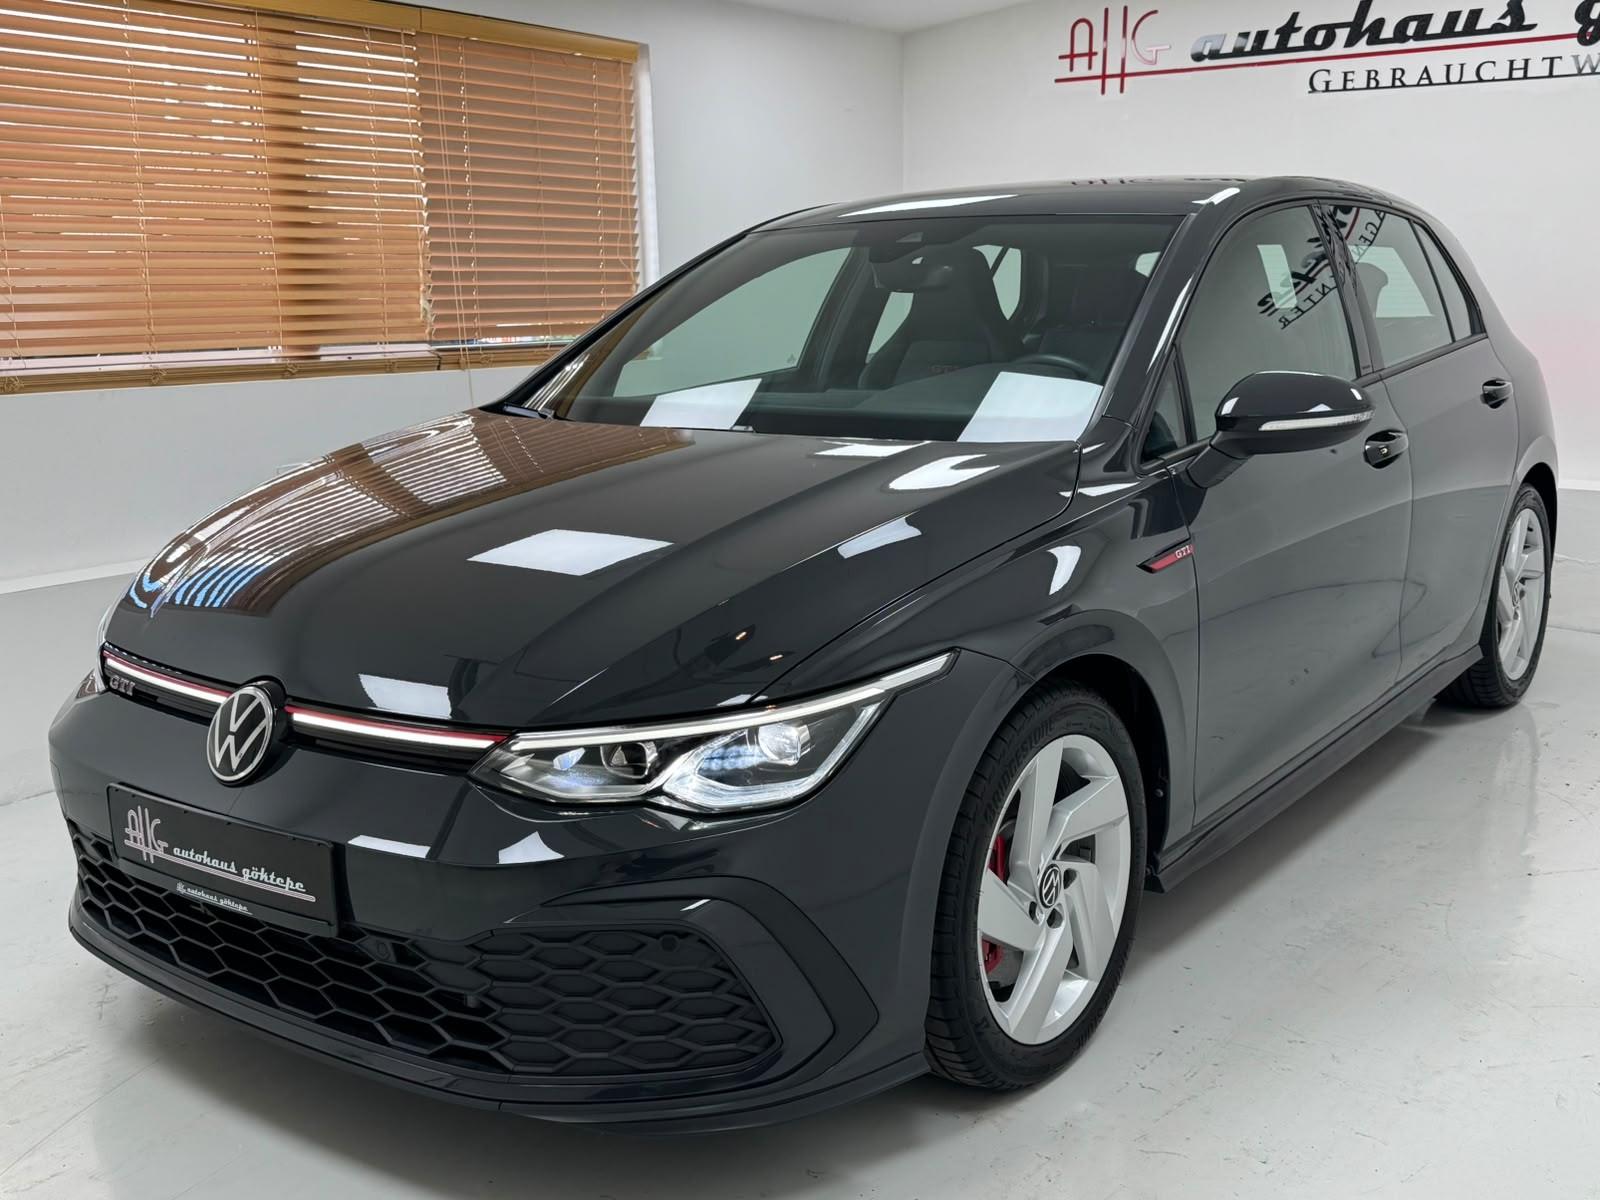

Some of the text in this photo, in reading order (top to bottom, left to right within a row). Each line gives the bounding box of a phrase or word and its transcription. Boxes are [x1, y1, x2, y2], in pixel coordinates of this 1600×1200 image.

[1190, 0, 1538, 62] autohaus
[1175, 544, 1193, 559] GTI
[109, 674, 136, 696] GTI
[173, 846, 237, 875] autohaus
[242, 863, 306, 892] göktepe
